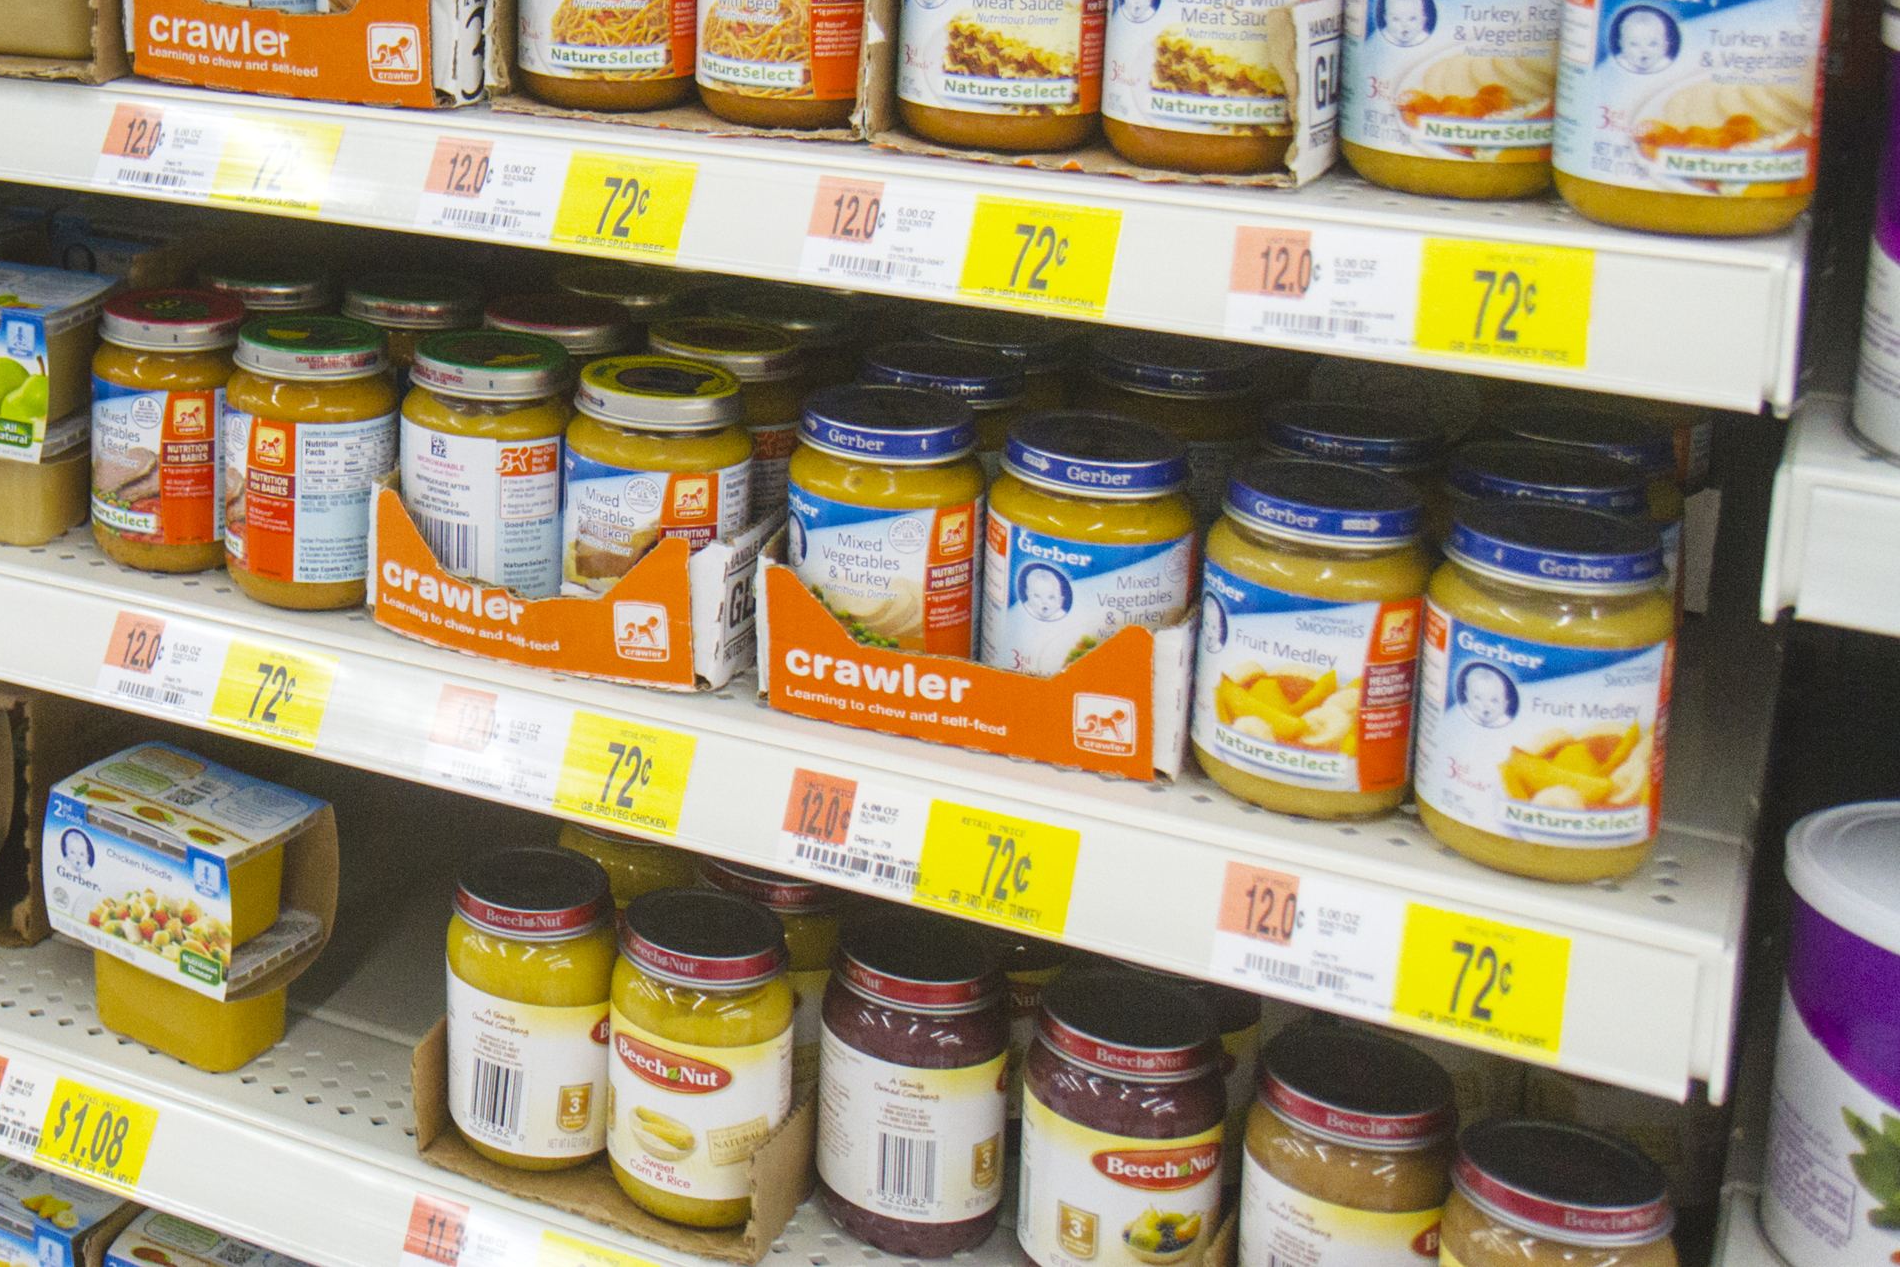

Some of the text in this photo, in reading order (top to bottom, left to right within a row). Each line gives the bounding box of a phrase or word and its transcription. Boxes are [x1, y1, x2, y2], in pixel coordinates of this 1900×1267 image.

[1461, 4, 1557, 24] Turkey, Rice
[1710, 30, 1808, 50] Turkey, Rice
[148, 46, 318, 78] Learning to chew and self-feed
[575, 236, 665, 253] GB 3RD SPAG W/BEEF
[1009, 224, 1070, 292] 72¢
[1474, 271, 1537, 342] 72¢
[166, 445, 211, 457] NUTRITION
[304, 439, 339, 450] Nutrition
[837, 533, 883, 553] Mixed
[821, 546, 900, 572] Vegetables
[932, 567, 972, 581] NUTRITION
[1116, 573, 1160, 592] Mixed
[383, 560, 525, 625] crawler
[1097, 589, 1173, 610] Vegetables
[1235, 627, 1338, 669] Fruit Medley
[1457, 631, 1544, 670] Gerber
[785, 648, 971, 703] crawler
[1532, 697, 1640, 722] Fruit Medley
[1083, 740, 1127, 753] crawler
[580, 801, 667, 829] GB 3RD VEG CHICKEN
[105, 849, 173, 882] Chicken Noodle
[182, 952, 219, 974] Nutritious
[1449, 941, 1514, 1021] 72¢
[472, 1013, 530, 1037] Owned Company
[53, 1099, 130, 1169] $1.08
[641, 1154, 675, 1174] Sweet
